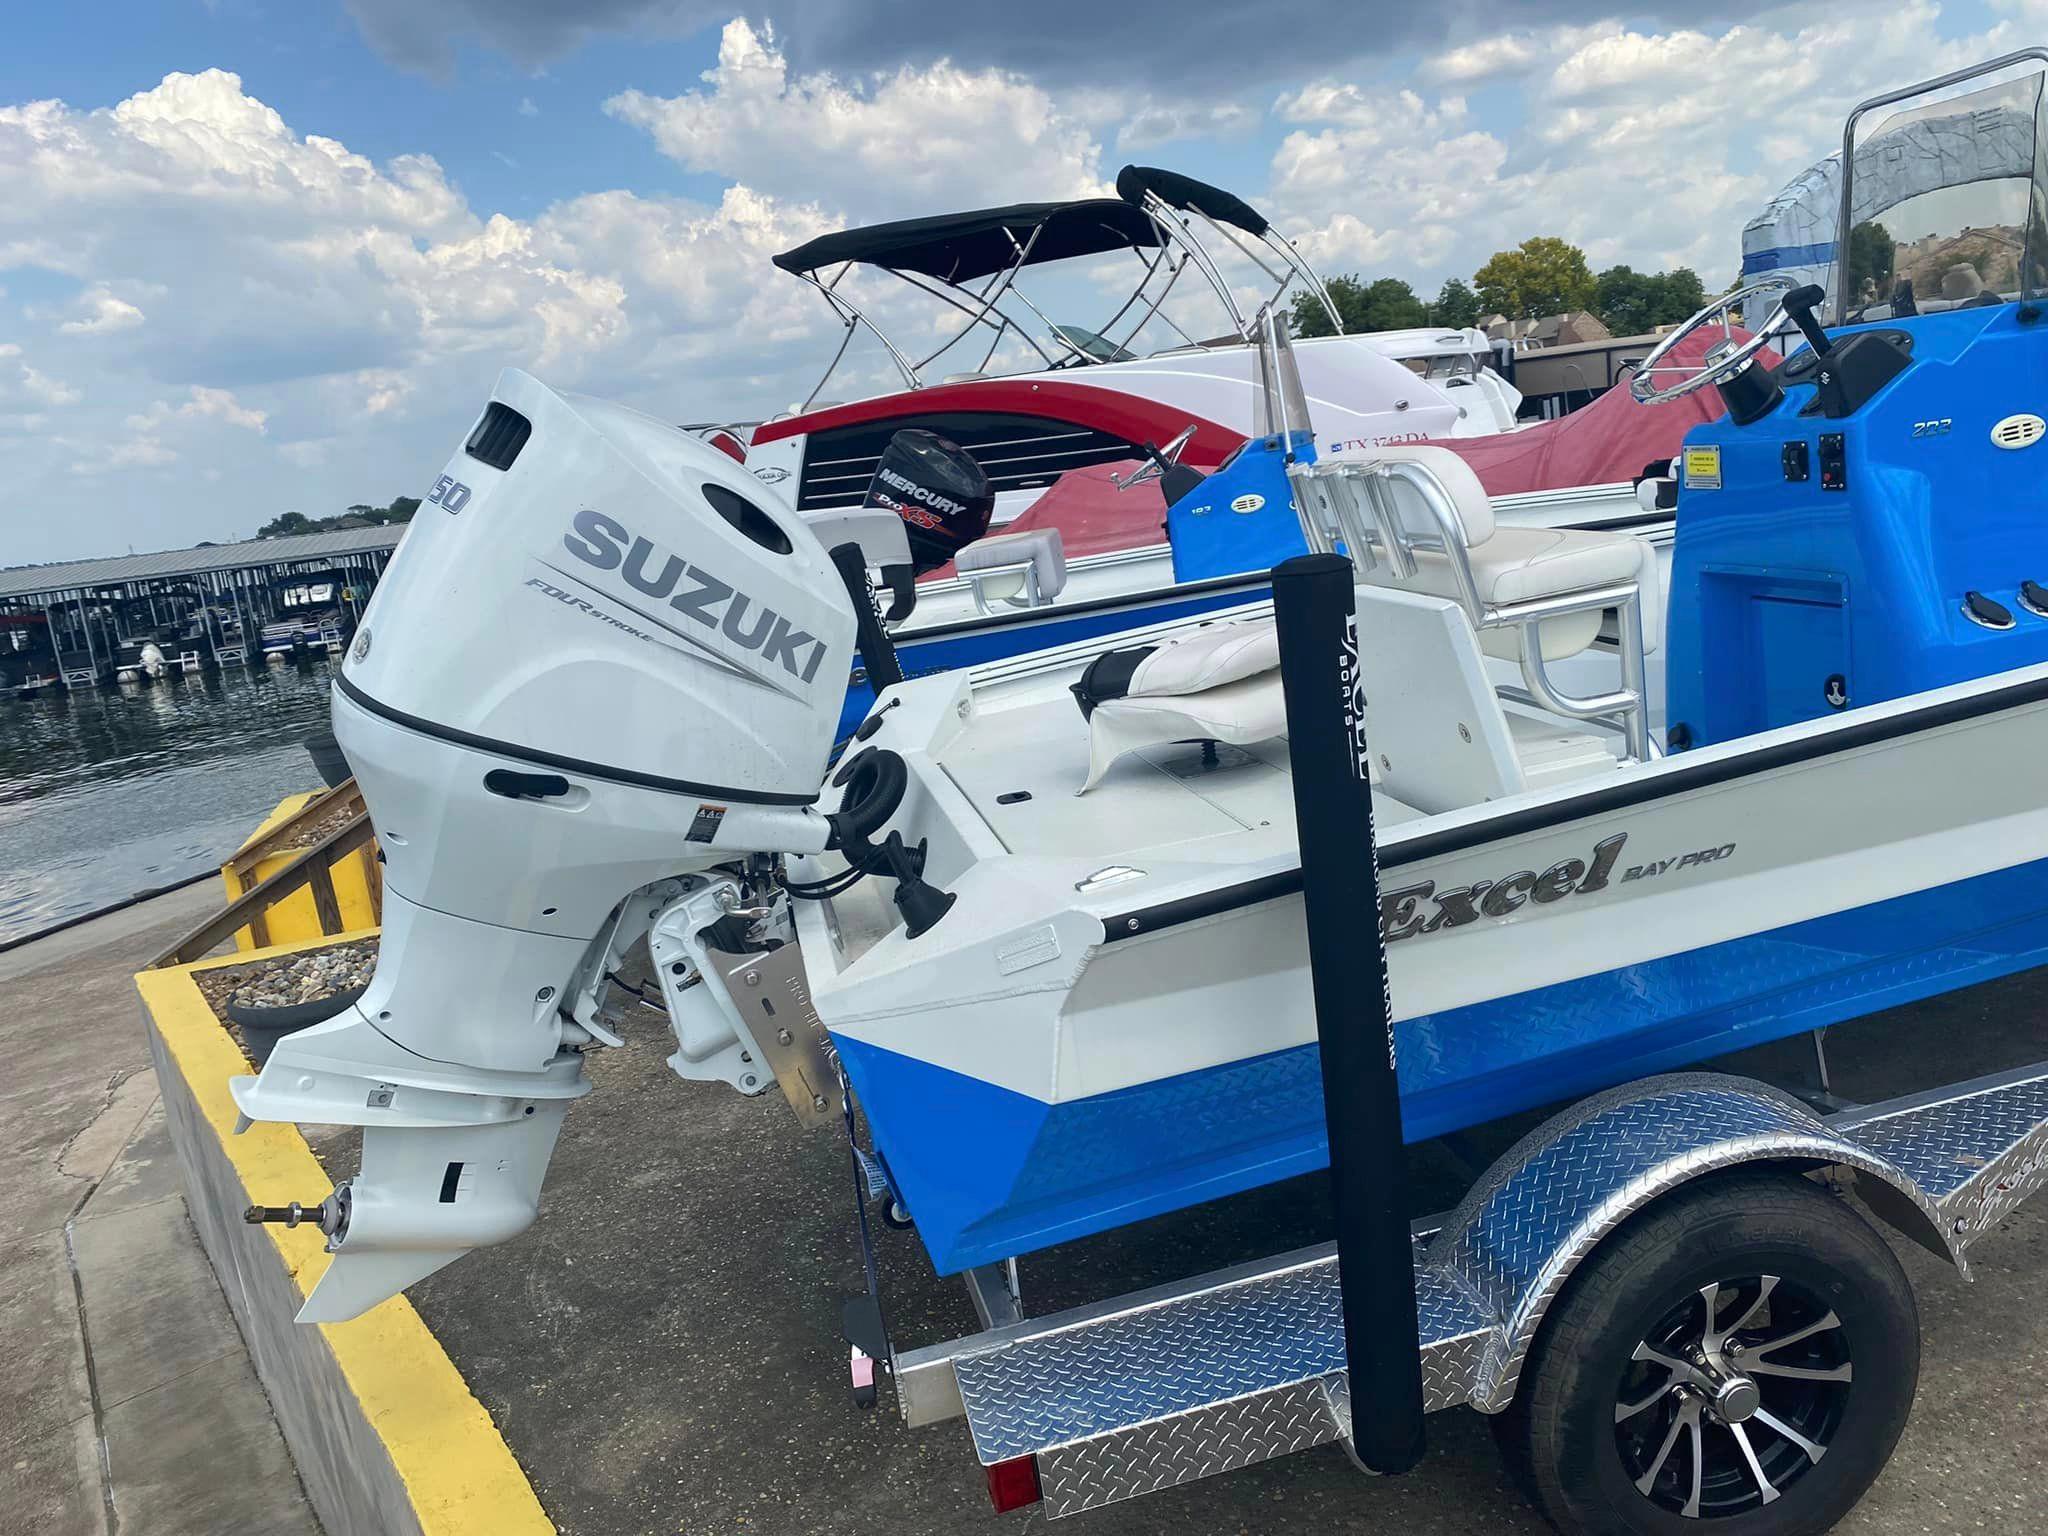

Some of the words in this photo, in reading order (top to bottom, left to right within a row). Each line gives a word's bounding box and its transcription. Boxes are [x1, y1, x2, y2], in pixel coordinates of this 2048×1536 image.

[1344, 438, 1368, 450] TX
[1912, 418, 1952, 438] 203
[879, 468, 967, 515] MERCURY
[524, 578, 594, 613] FOUR
[589, 610, 655, 642] STROKE
[564, 510, 828, 685] SUZUKI
[1339, 654, 1354, 726] BOATS
[1379, 832, 1628, 943] Excel
[1620, 856, 1678, 883] BAY
[1675, 843, 1736, 870] PRO
